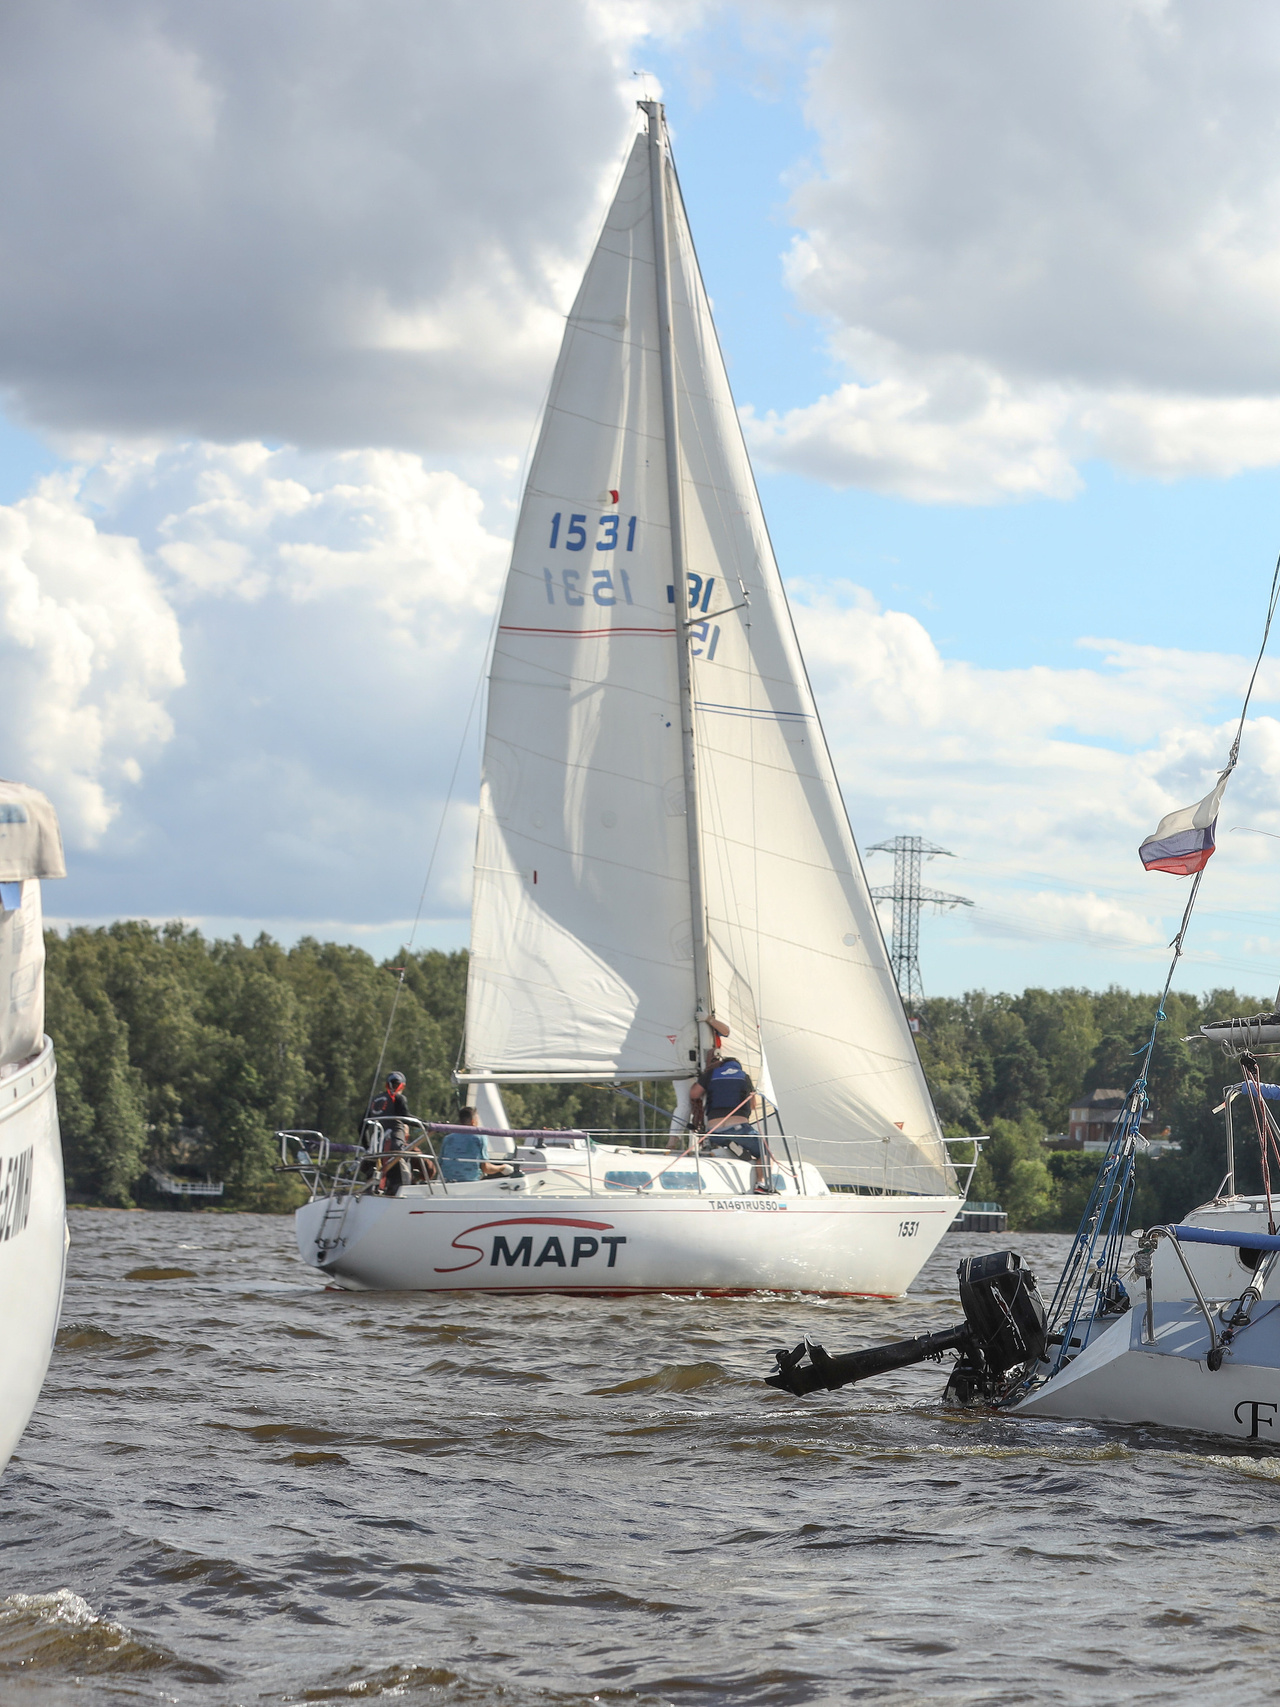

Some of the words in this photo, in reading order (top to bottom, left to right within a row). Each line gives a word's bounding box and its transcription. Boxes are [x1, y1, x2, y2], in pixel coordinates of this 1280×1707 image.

[549, 512, 637, 551] 1531
[708, 1200, 778, 1211] TA1461RUS50
[898, 1221, 920, 1237] 1531
